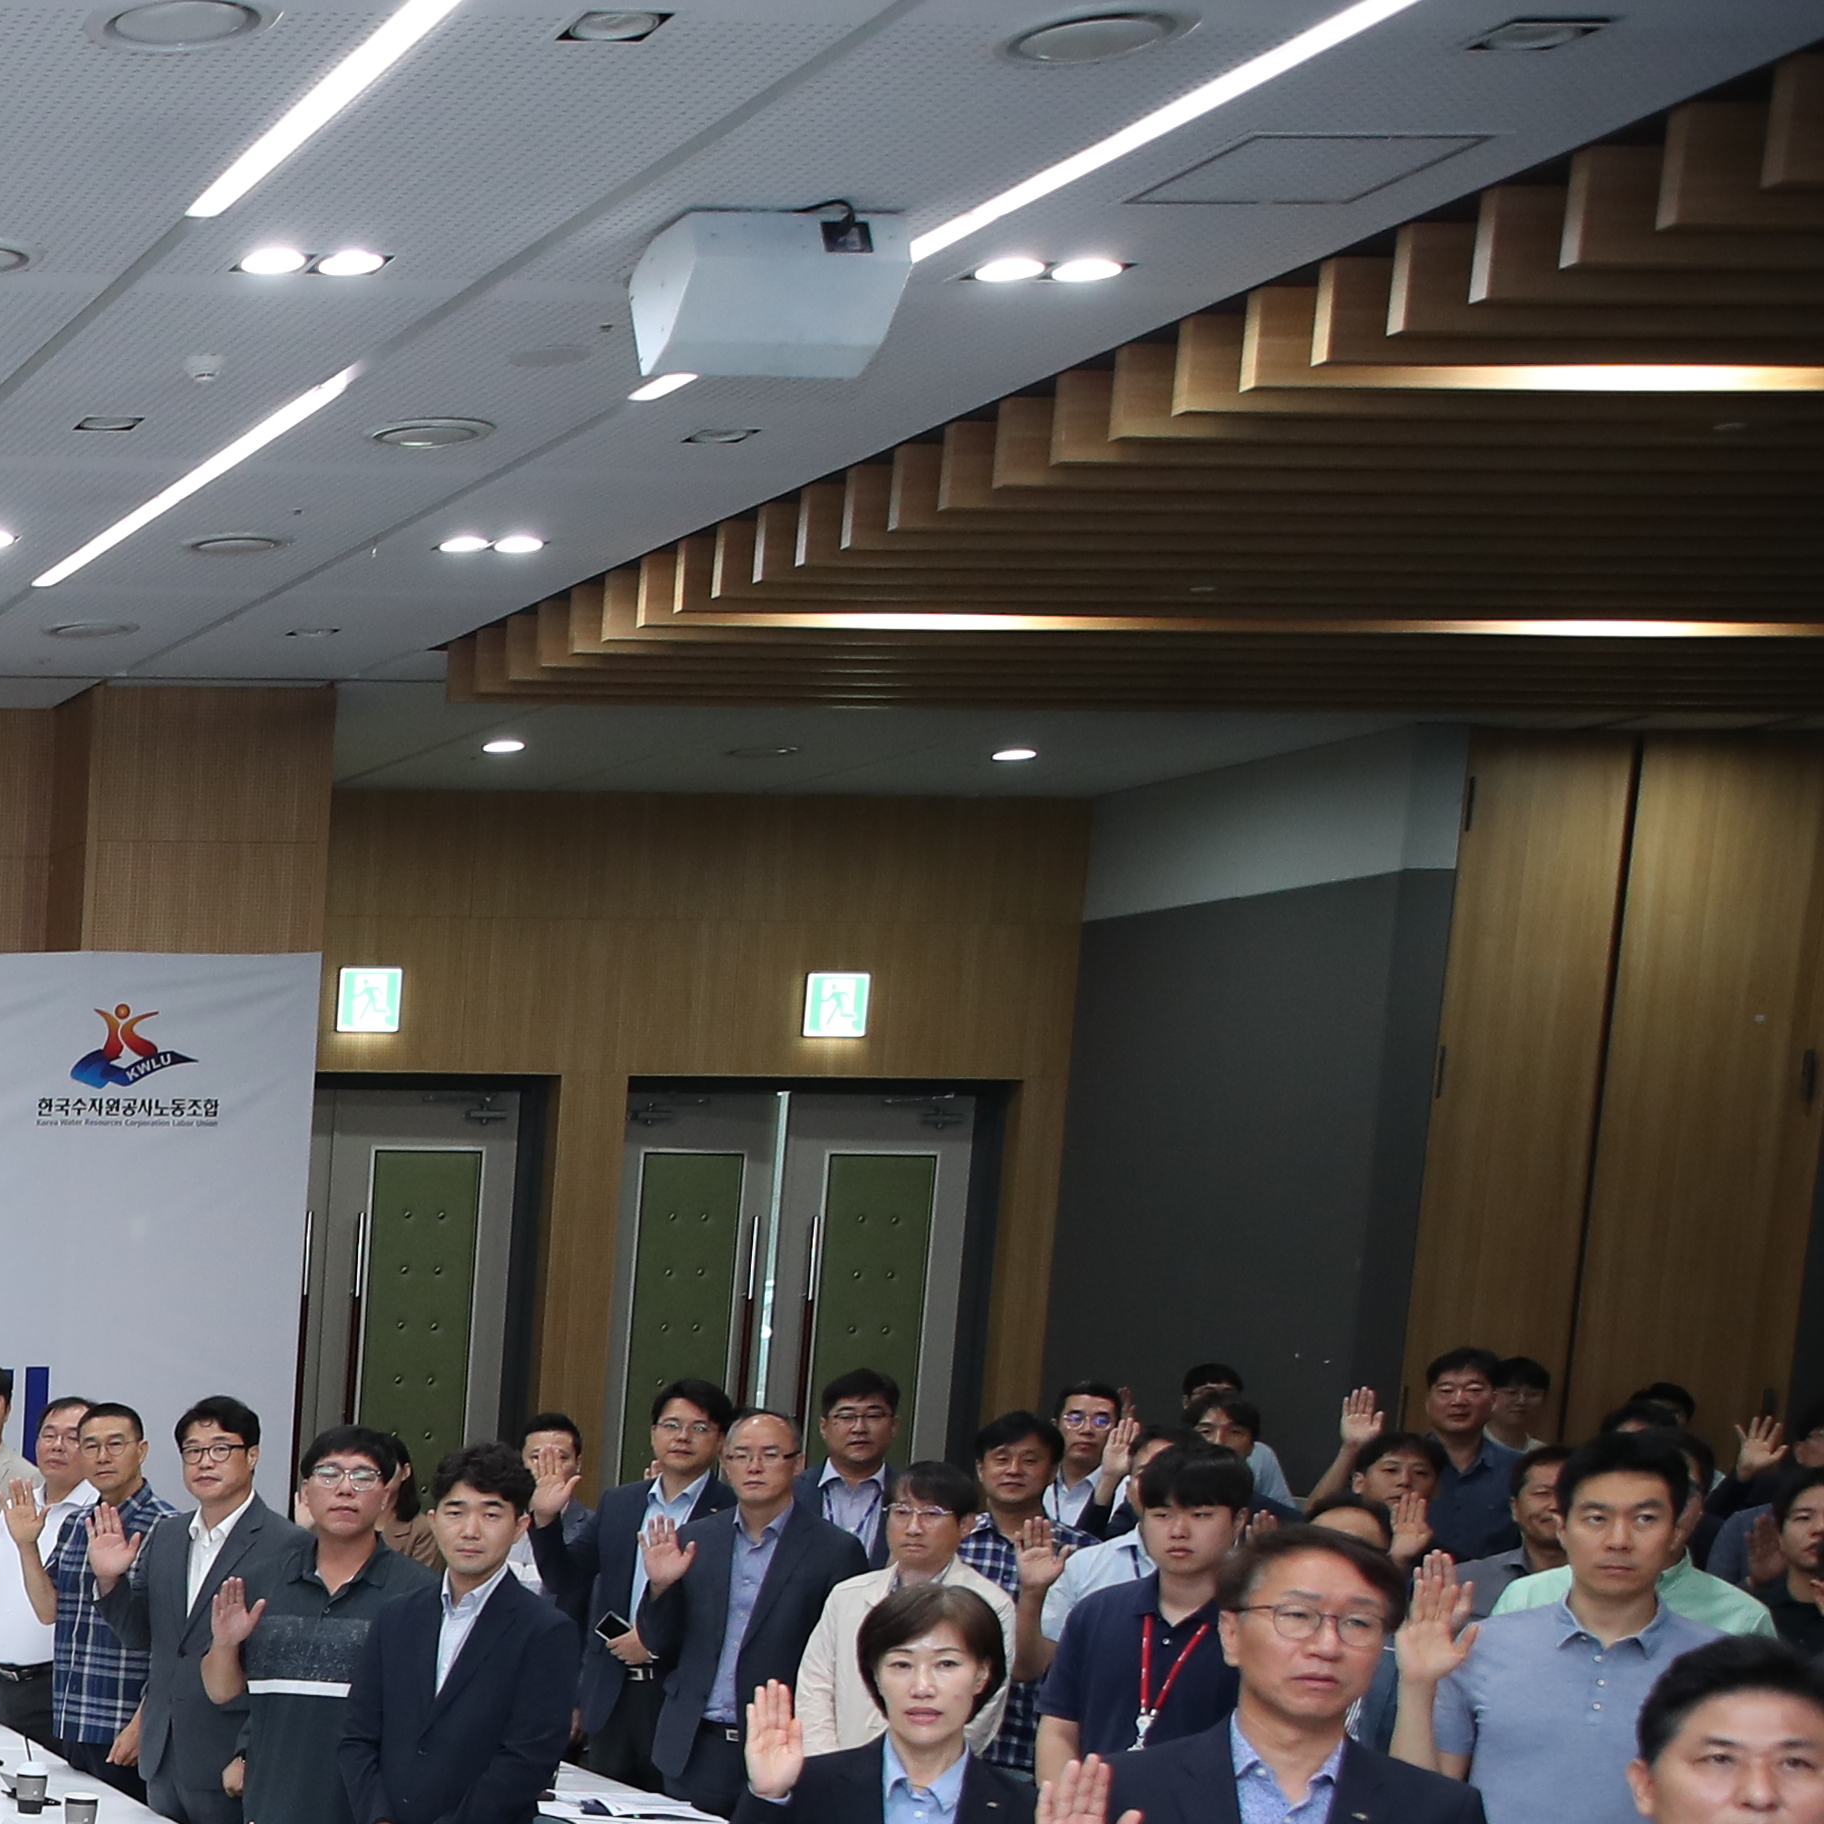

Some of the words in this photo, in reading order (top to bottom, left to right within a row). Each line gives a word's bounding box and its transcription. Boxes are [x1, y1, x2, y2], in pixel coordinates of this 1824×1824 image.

[125, 1053, 173, 1083] KWLU
[37, 1097, 219, 1118] 한국수자원공사노동조합
[36, 1118, 59, 1127] Korea
[60, 1118, 83, 1127] Water
[84, 1118, 123, 1127] Resources
[124, 1119, 170, 1128] Corporation
